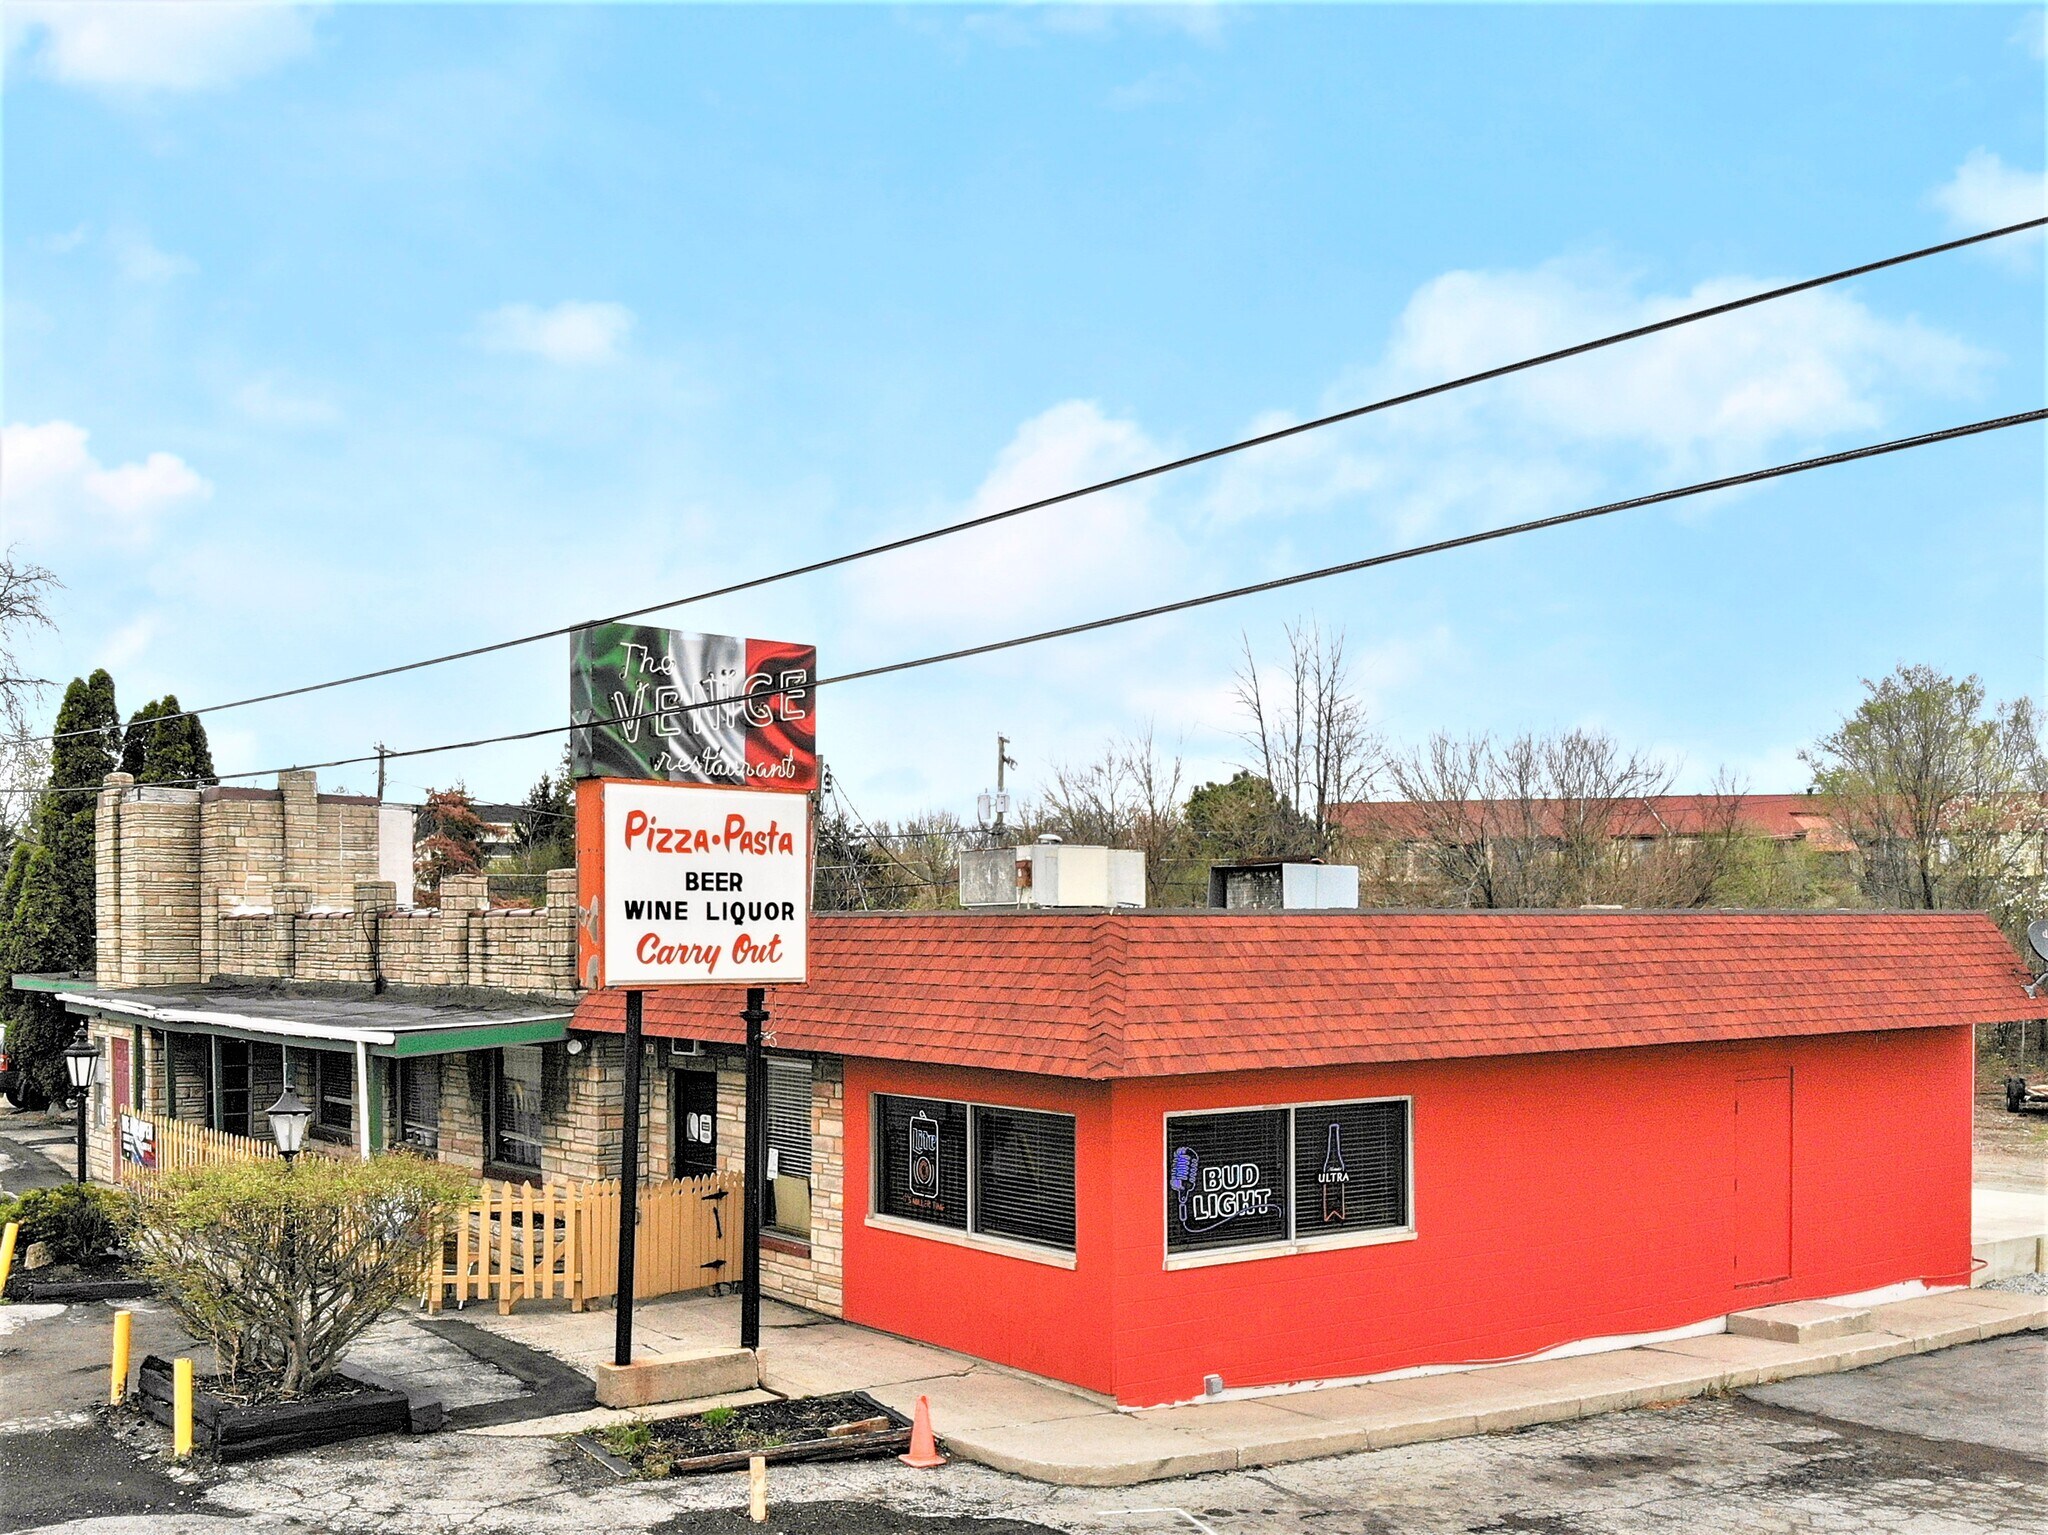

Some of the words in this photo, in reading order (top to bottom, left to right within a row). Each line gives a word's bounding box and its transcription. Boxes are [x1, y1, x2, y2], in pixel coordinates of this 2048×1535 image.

[619, 642, 676, 681] The
[611, 668, 807, 744] VENICE
[654, 748, 796, 781] restaurant
[685, 871, 743, 892] BEER
[624, 900, 688, 921] WINE
[706, 901, 795, 925] LIQUOR
[636, 932, 722, 974] Carry
[732, 933, 783, 965] Out
[912, 1127, 937, 1155] Lite
[1203, 1163, 1260, 1192] BUD
[1318, 1172, 1350, 1183] ULTRA
[1193, 1189, 1271, 1220] LIGHT
